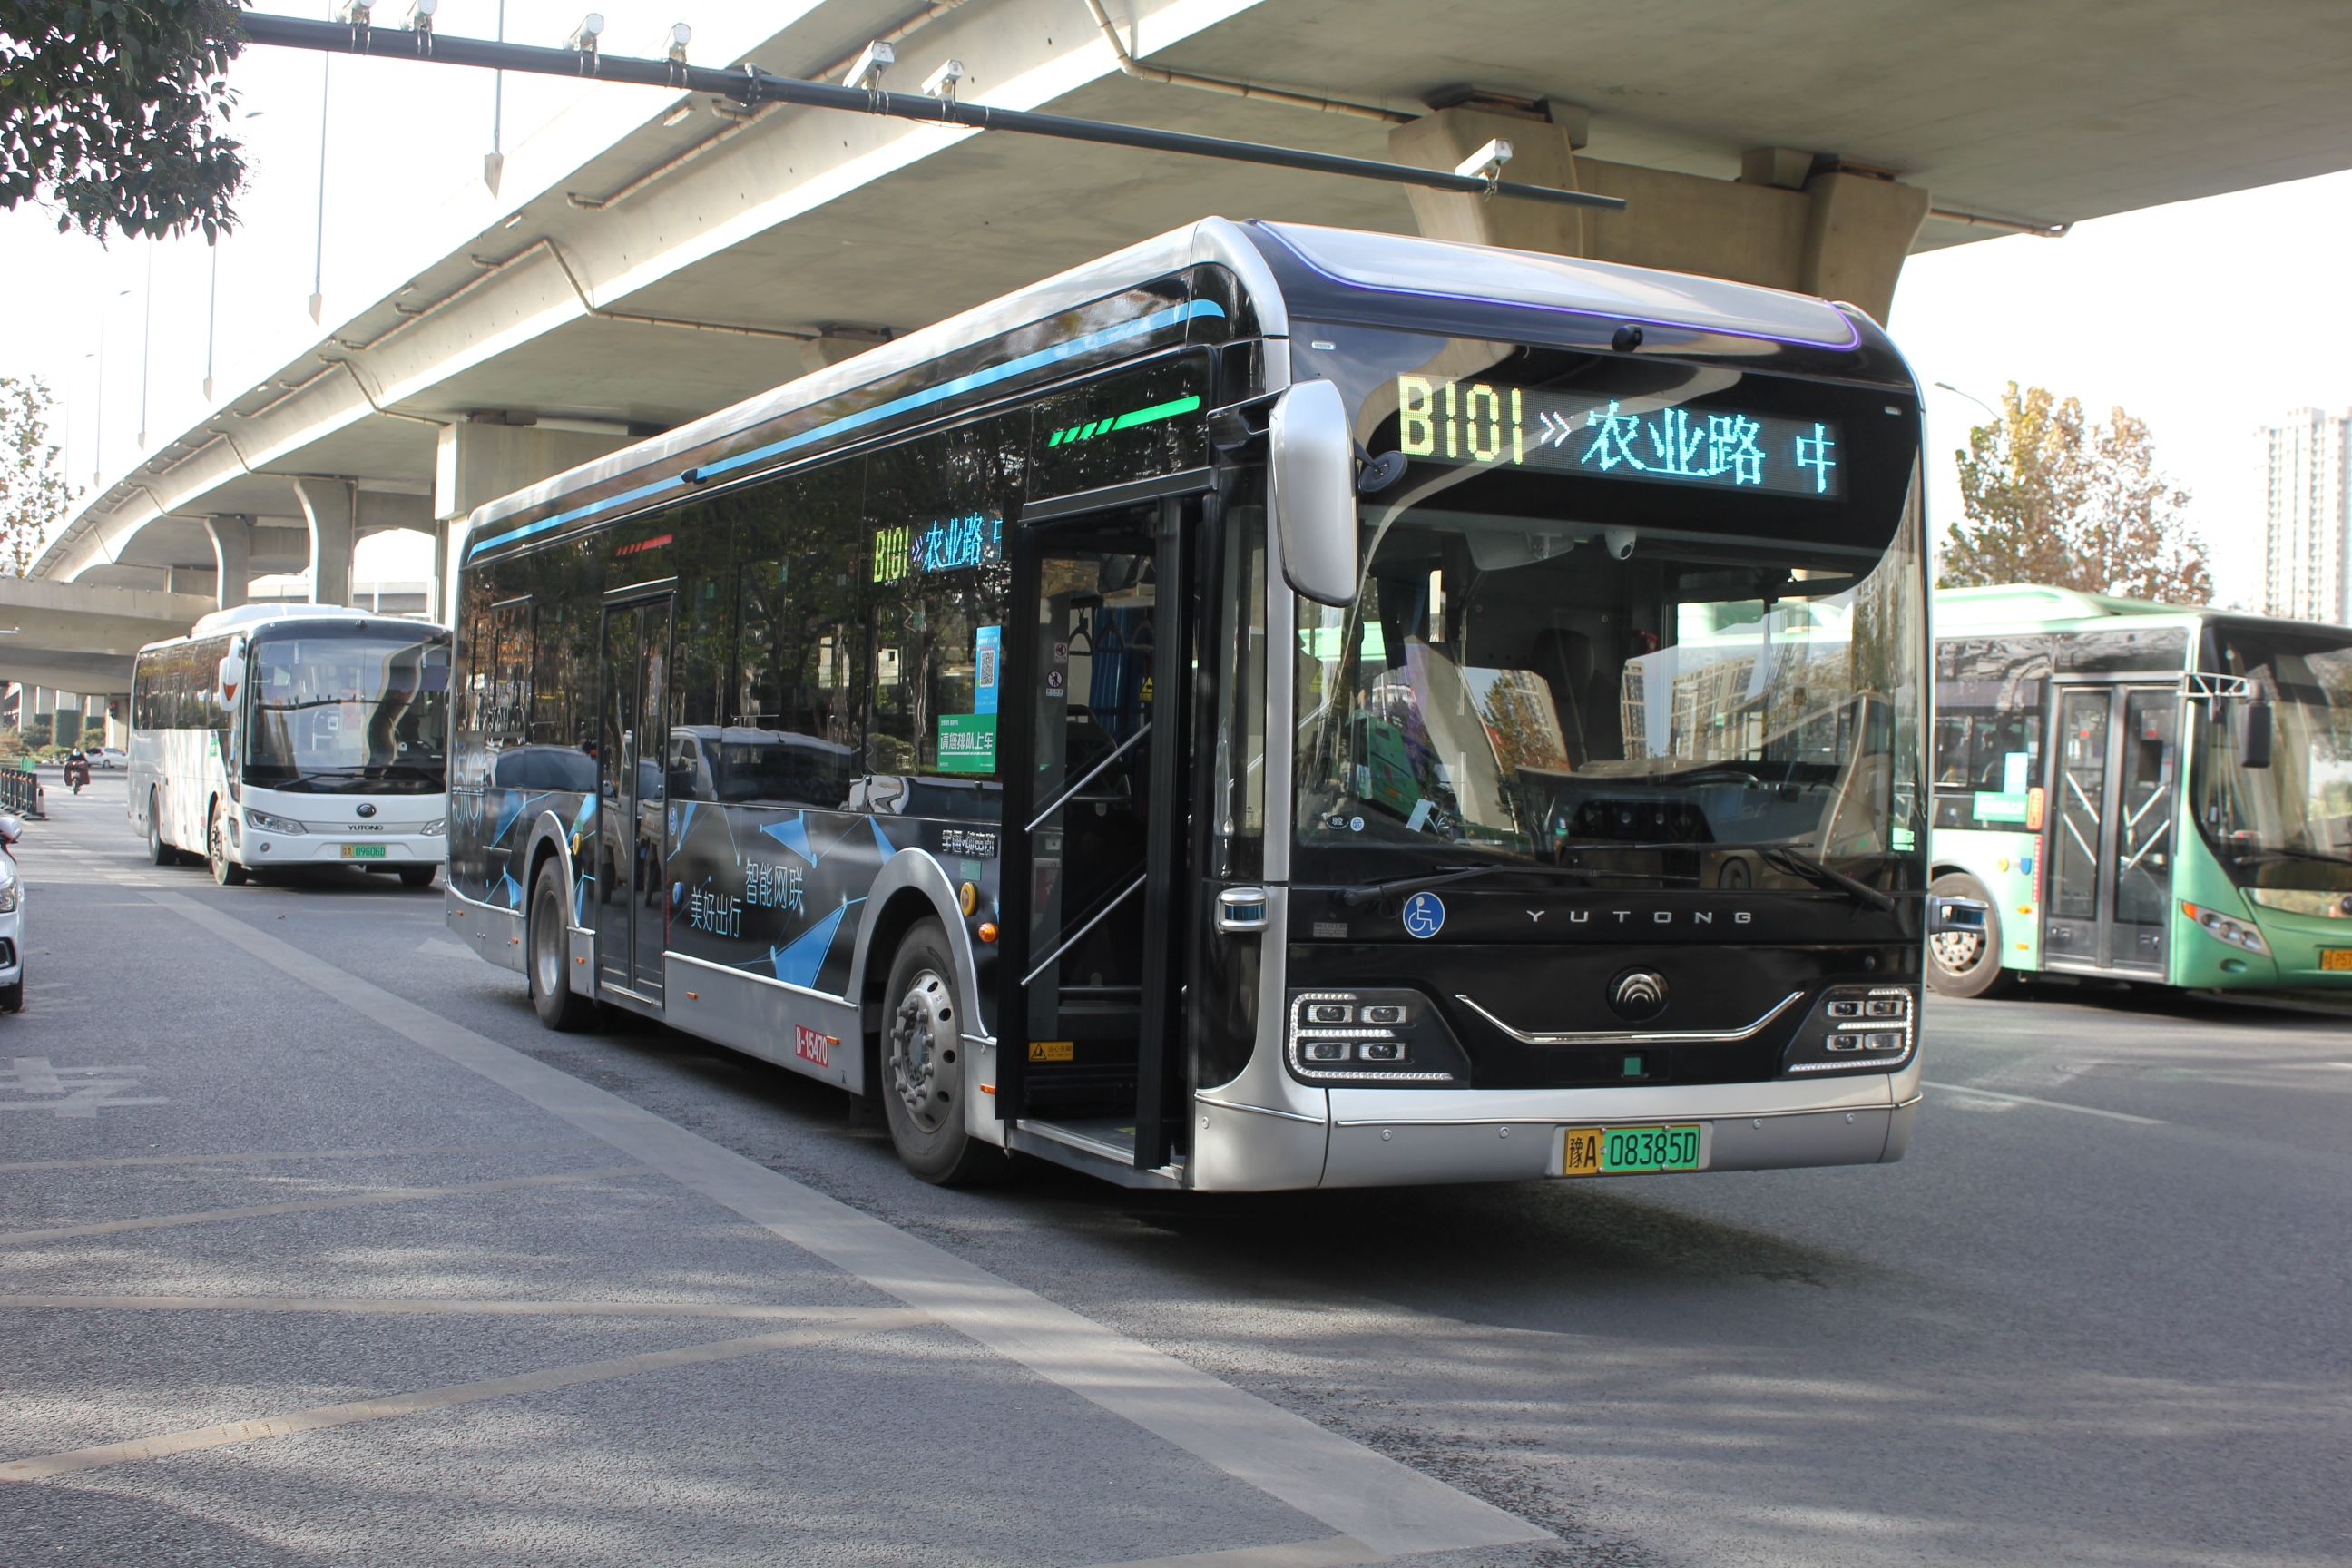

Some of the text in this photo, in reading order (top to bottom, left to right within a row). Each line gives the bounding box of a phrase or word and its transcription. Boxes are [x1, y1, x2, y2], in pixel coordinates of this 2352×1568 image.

[1399, 375, 1524, 466] B101
[1581, 399, 1766, 485] 农业路
[874, 525, 909, 583] B101
[920, 512, 984, 573] 农业路
[940, 731, 994, 750] 请您排队上车
[691, 885, 742, 937] 美好出行
[745, 858, 804, 912] 智能网联
[1526, 910, 1752, 925] YUTONG
[796, 1026, 828, 1065] B-15470
